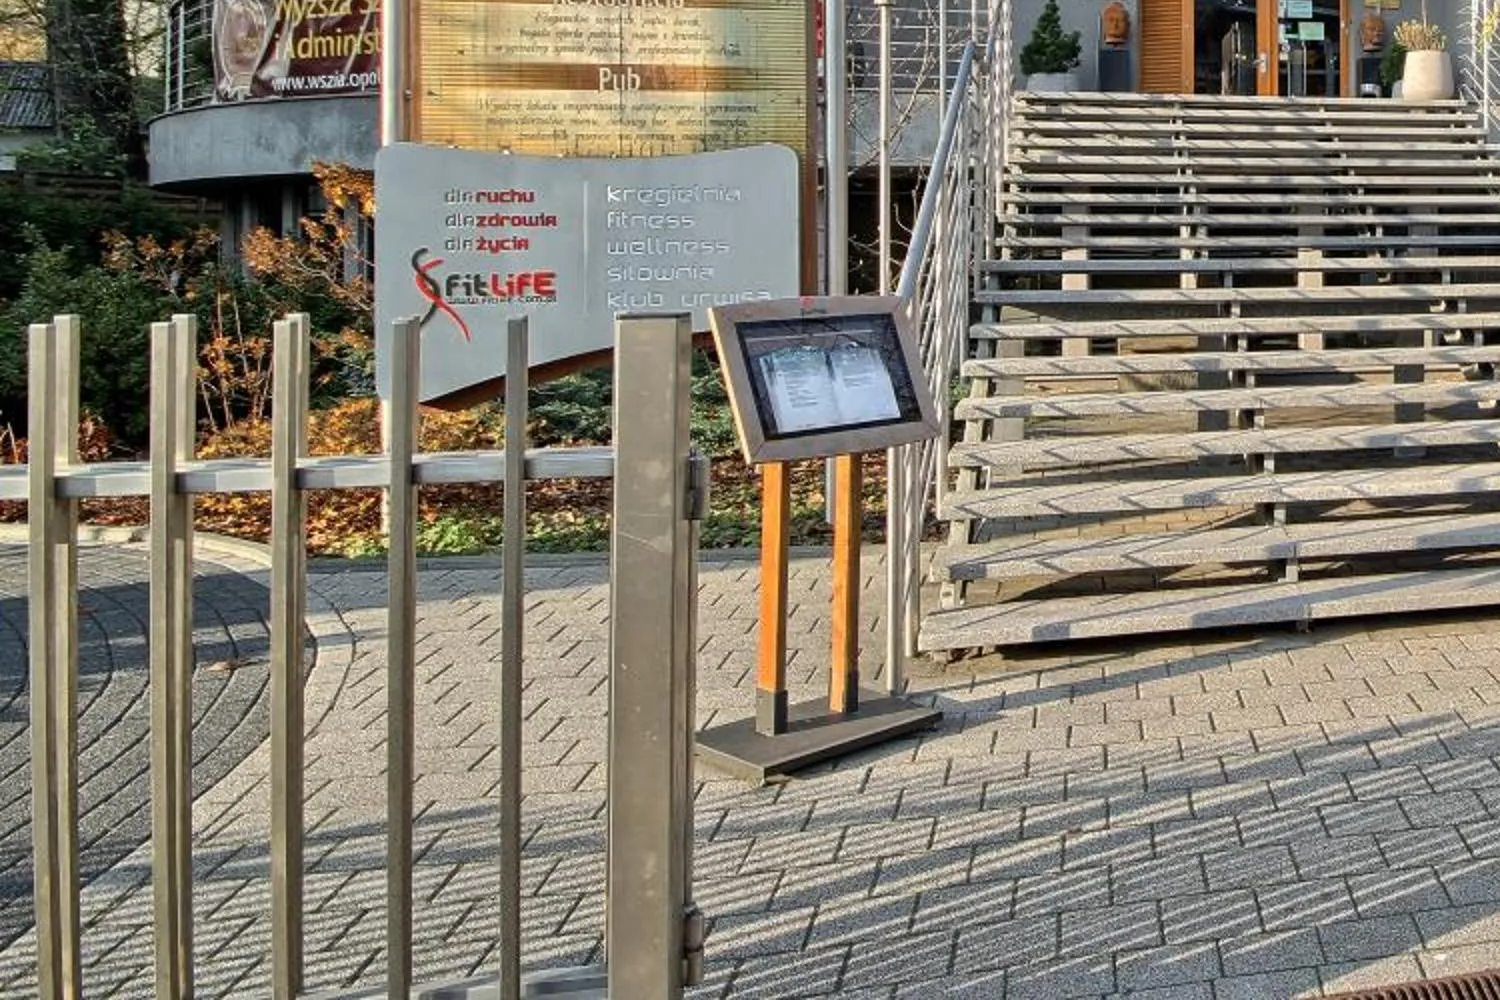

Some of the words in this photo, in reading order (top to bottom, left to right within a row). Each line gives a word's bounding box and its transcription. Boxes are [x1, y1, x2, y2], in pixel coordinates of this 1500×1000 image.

[598, 68, 641, 92] Pub
[475, 188, 536, 203] ruchu
[475, 211, 559, 228] zdrowia
[606, 210, 697, 229] fitness
[606, 237, 731, 255] wellness
[606, 290, 664, 309] klub
